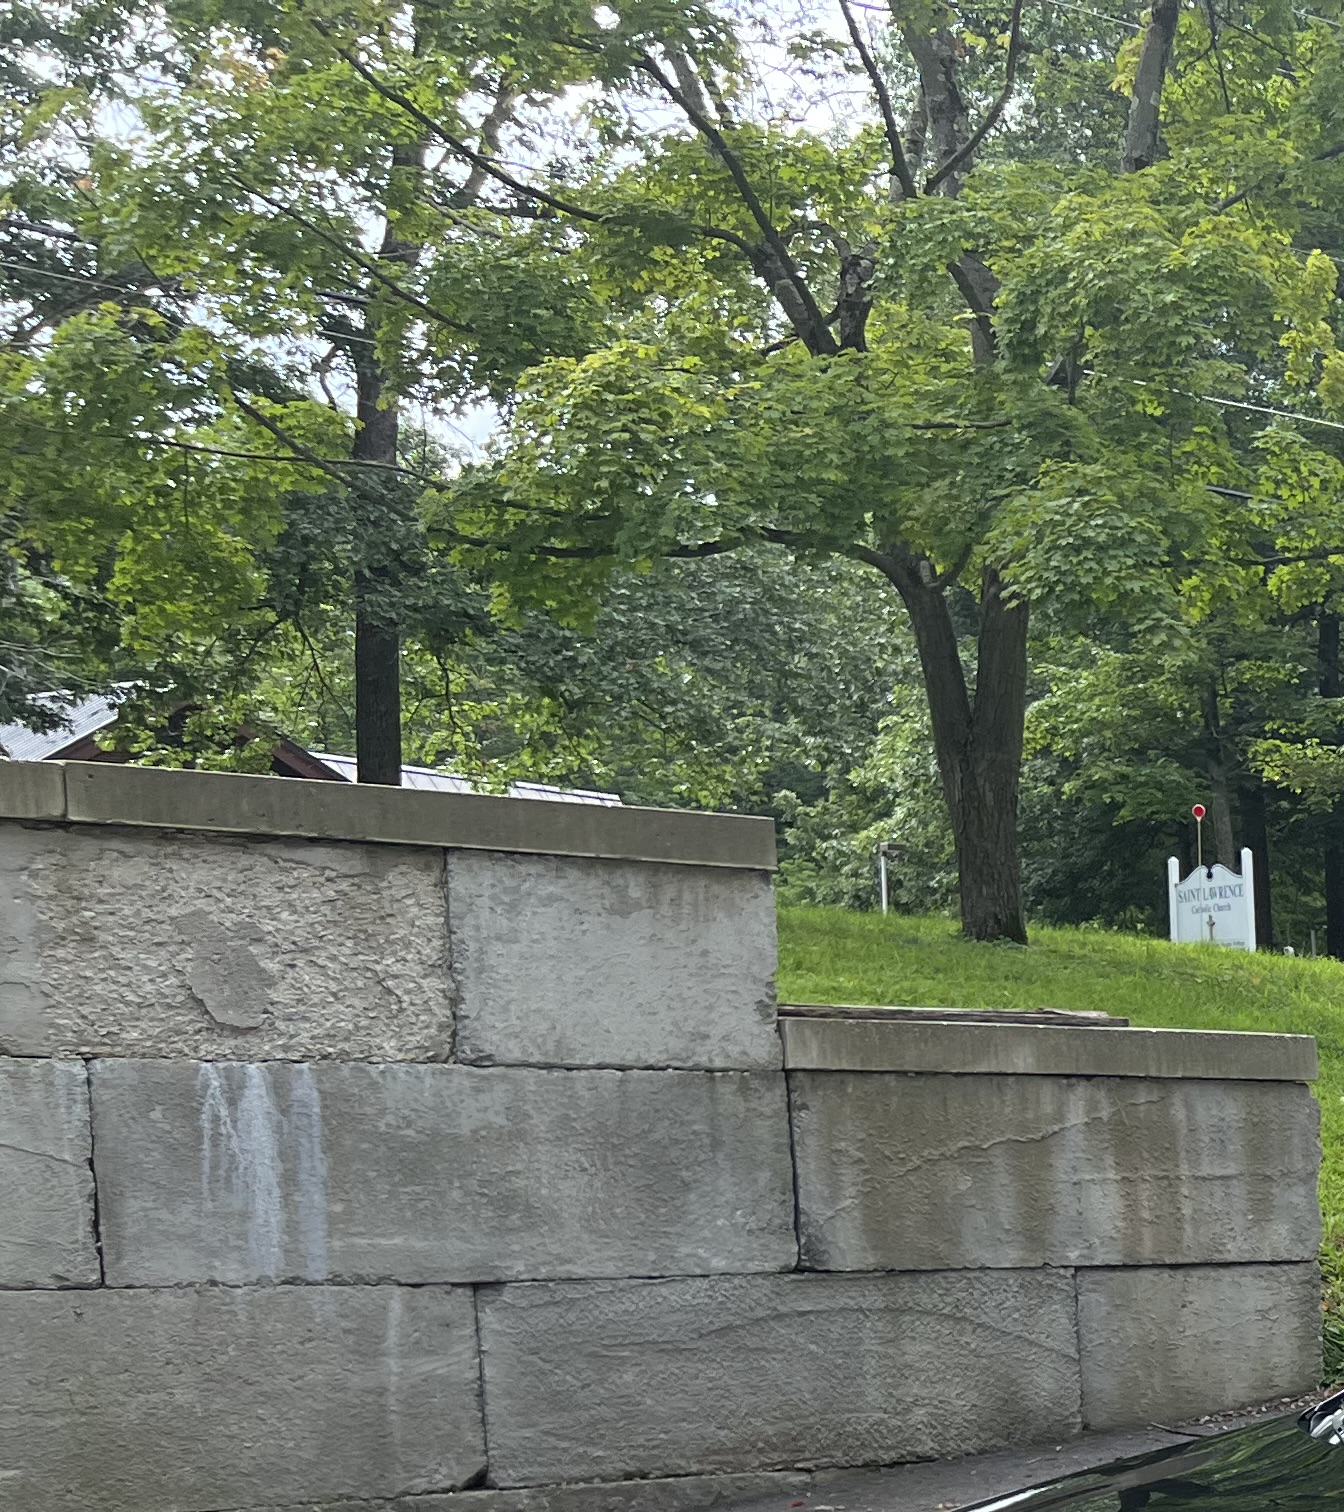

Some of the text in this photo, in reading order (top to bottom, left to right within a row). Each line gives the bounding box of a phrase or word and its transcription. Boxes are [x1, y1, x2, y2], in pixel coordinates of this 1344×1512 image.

[1178, 884, 1244, 903] SAINT LAWRENCE
[1213, 902, 1231, 912] Church
